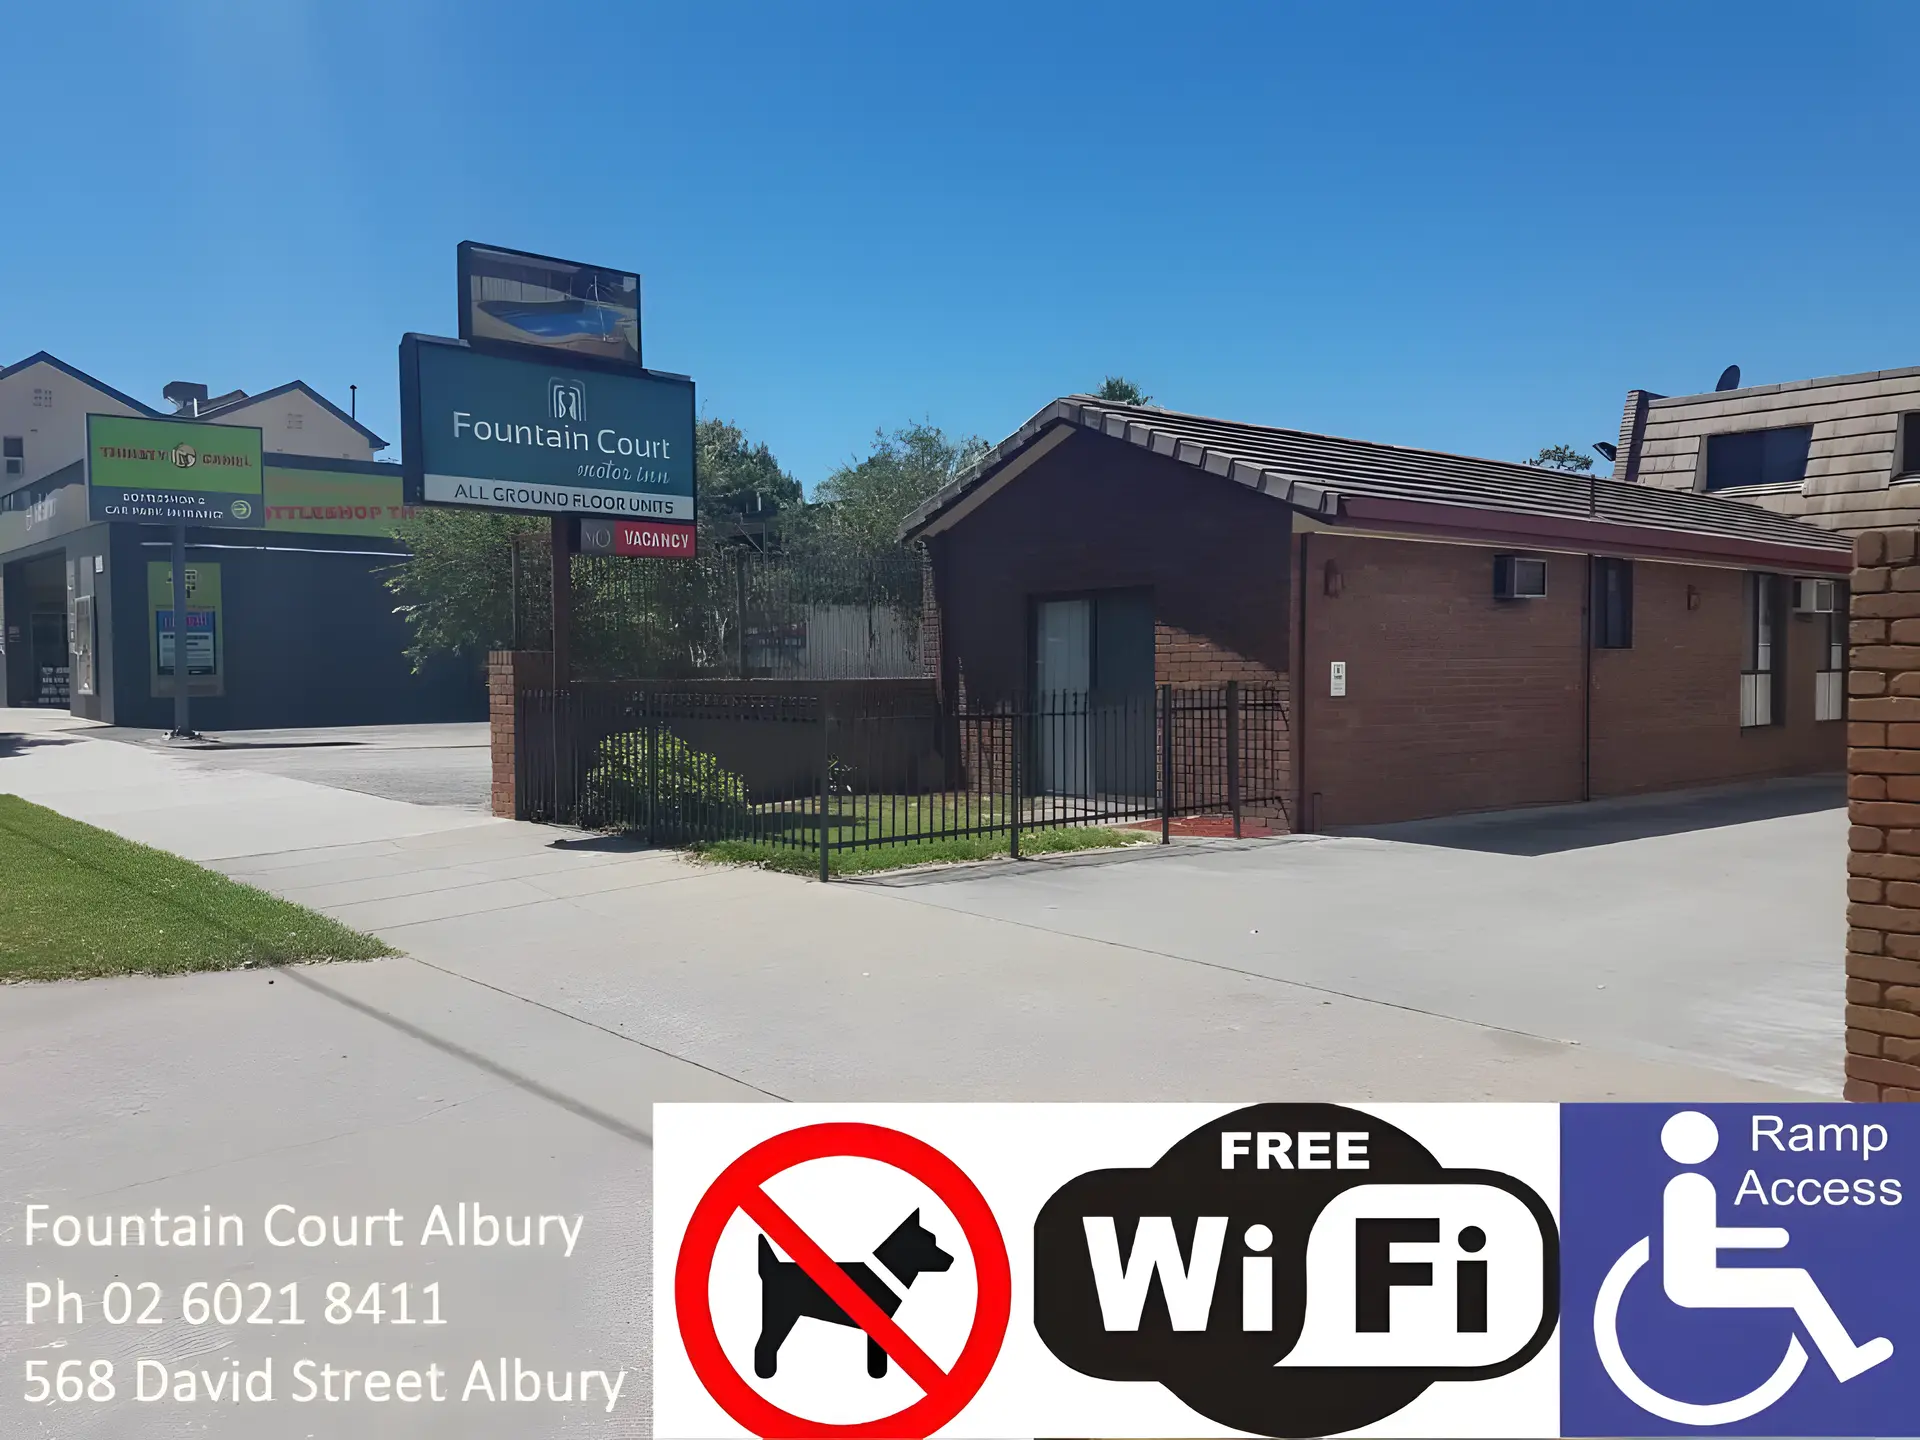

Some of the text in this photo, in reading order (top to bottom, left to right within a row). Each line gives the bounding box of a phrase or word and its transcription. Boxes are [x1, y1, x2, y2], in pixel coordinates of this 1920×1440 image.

[452, 411, 670, 459] Fountain Court
[454, 483, 674, 515] ALL GROUND FLOOR UNITS
[624, 529, 689, 549] VACANCY
